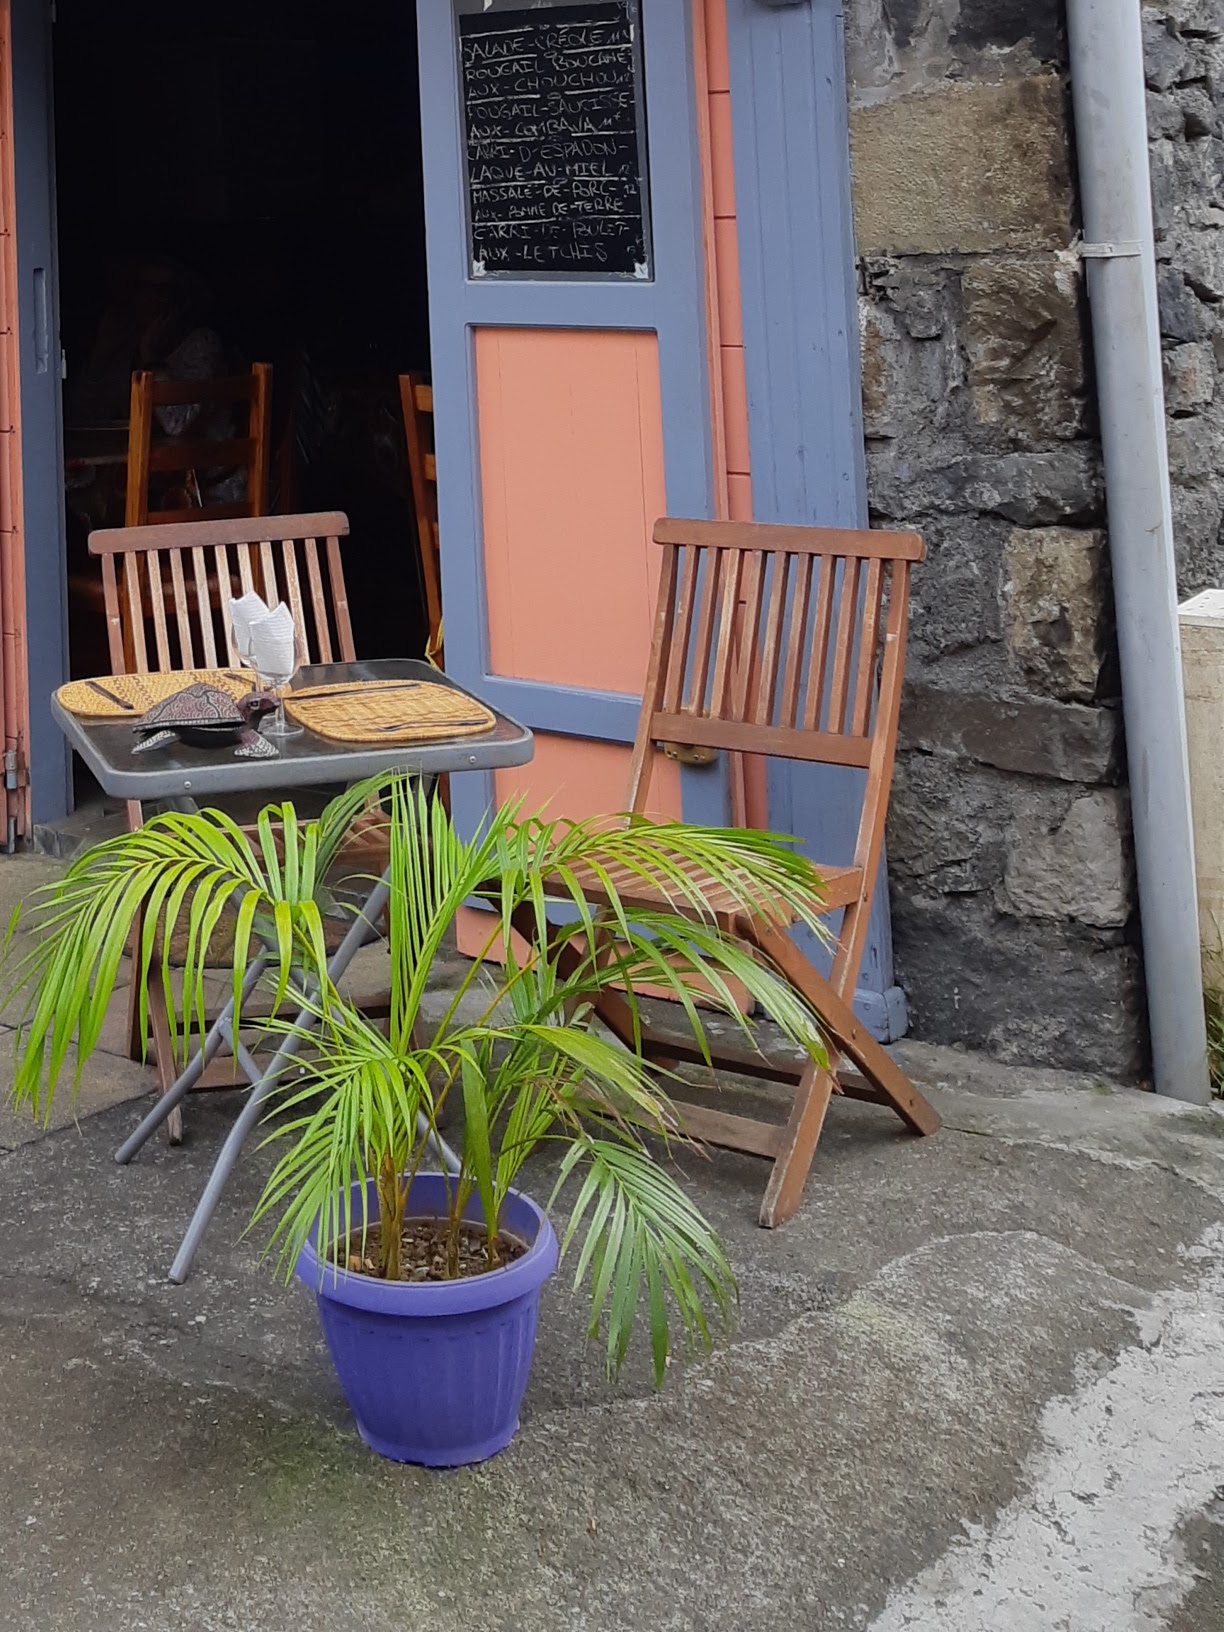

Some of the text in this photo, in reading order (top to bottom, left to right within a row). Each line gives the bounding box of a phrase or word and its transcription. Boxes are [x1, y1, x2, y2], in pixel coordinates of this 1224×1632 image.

[464, 38, 524, 63] SALADE
[466, 60, 544, 82] ROUGAIL
[470, 124, 502, 139] AUX
[534, 162, 556, 177] AU
[566, 160, 613, 176] MIEL
[572, 181, 609, 198] PORC
[552, 202, 568, 216] DE
[575, 197, 624, 213] TERRE
